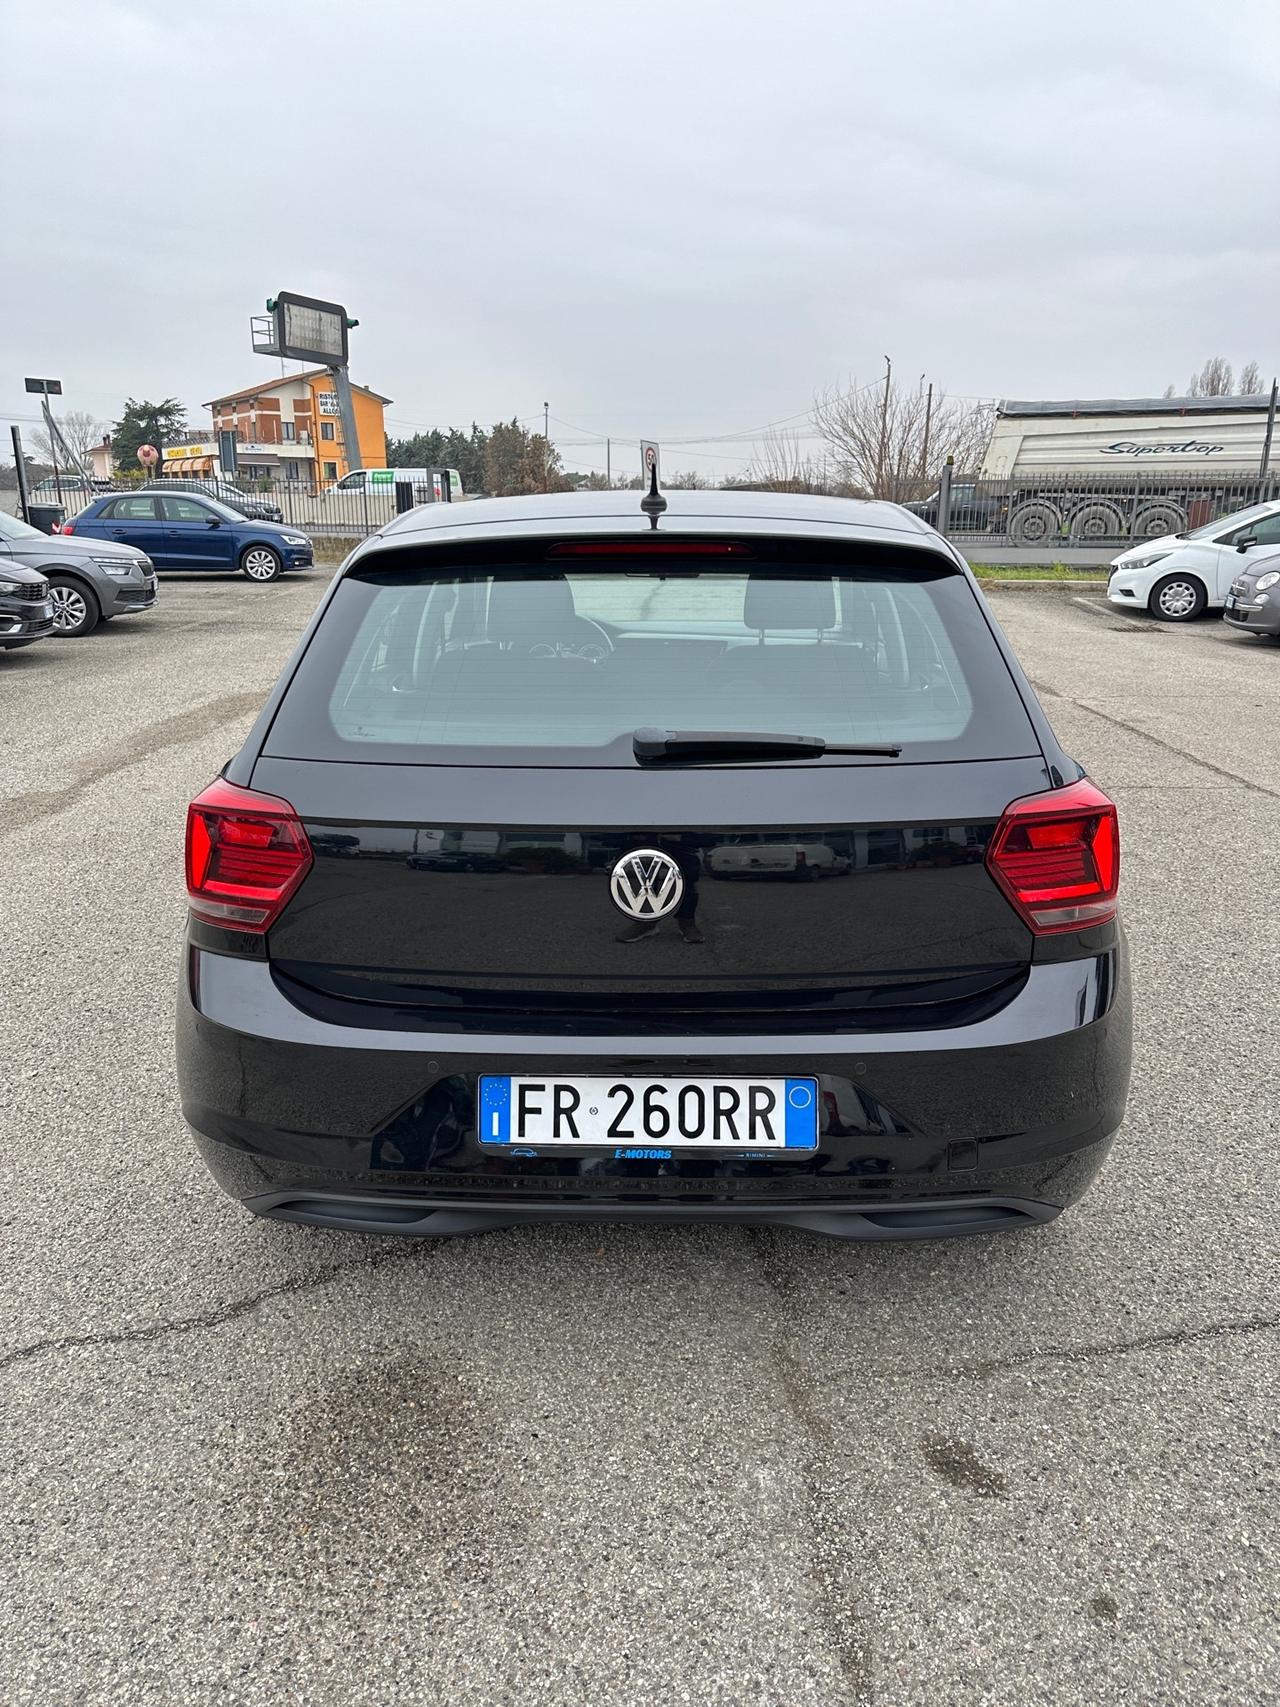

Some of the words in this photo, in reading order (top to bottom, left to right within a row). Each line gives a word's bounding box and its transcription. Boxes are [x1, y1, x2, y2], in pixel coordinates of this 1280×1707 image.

[1099, 440, 1224, 457] Supertop
[518, 1084, 580, 1138] FR
[607, 1084, 776, 1140] 260RR
[614, 1149, 672, 1159] E-MOTORS
